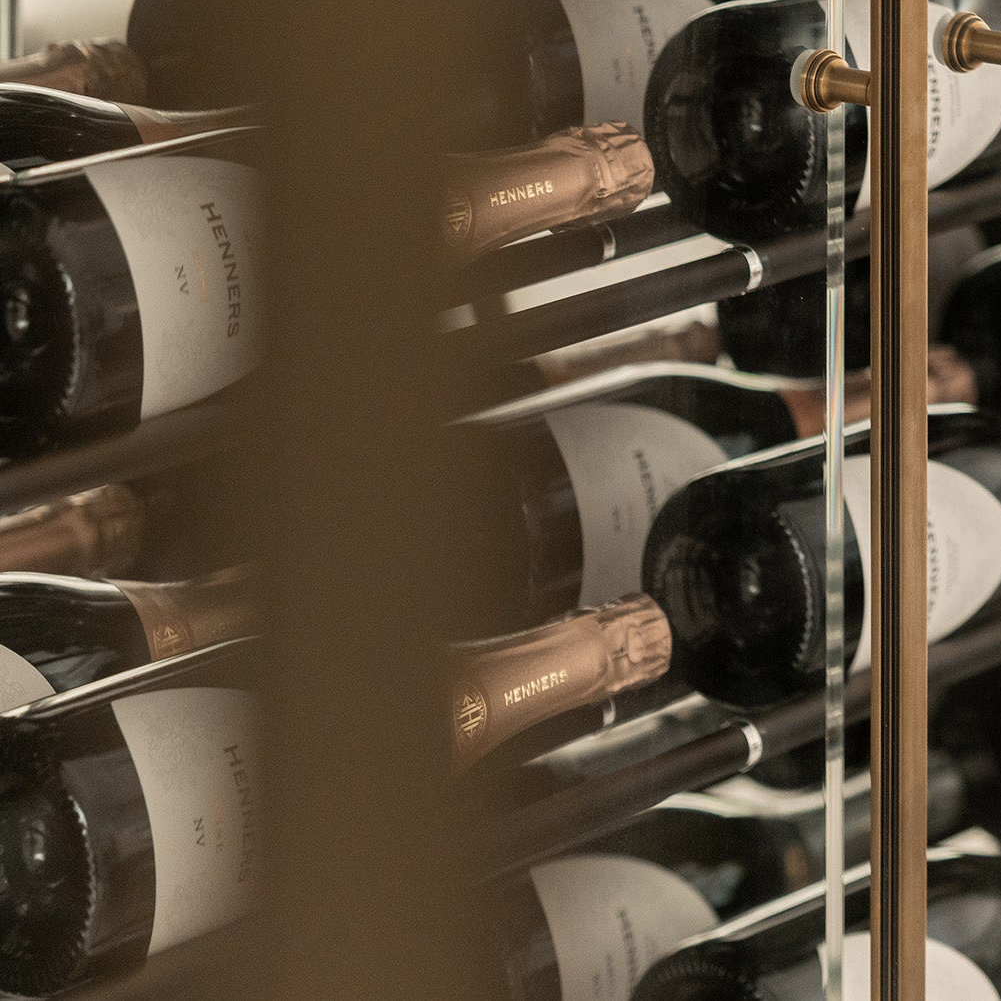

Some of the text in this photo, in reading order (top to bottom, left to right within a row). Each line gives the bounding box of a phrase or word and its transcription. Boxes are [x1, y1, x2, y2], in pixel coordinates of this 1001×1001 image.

[489, 180, 553, 207] HENNERS
[174, 264, 190, 296] NV
[200, 202, 241, 339] HENNERS
[504, 670, 568, 706] HENNERS
[193, 818, 206, 847] NV
